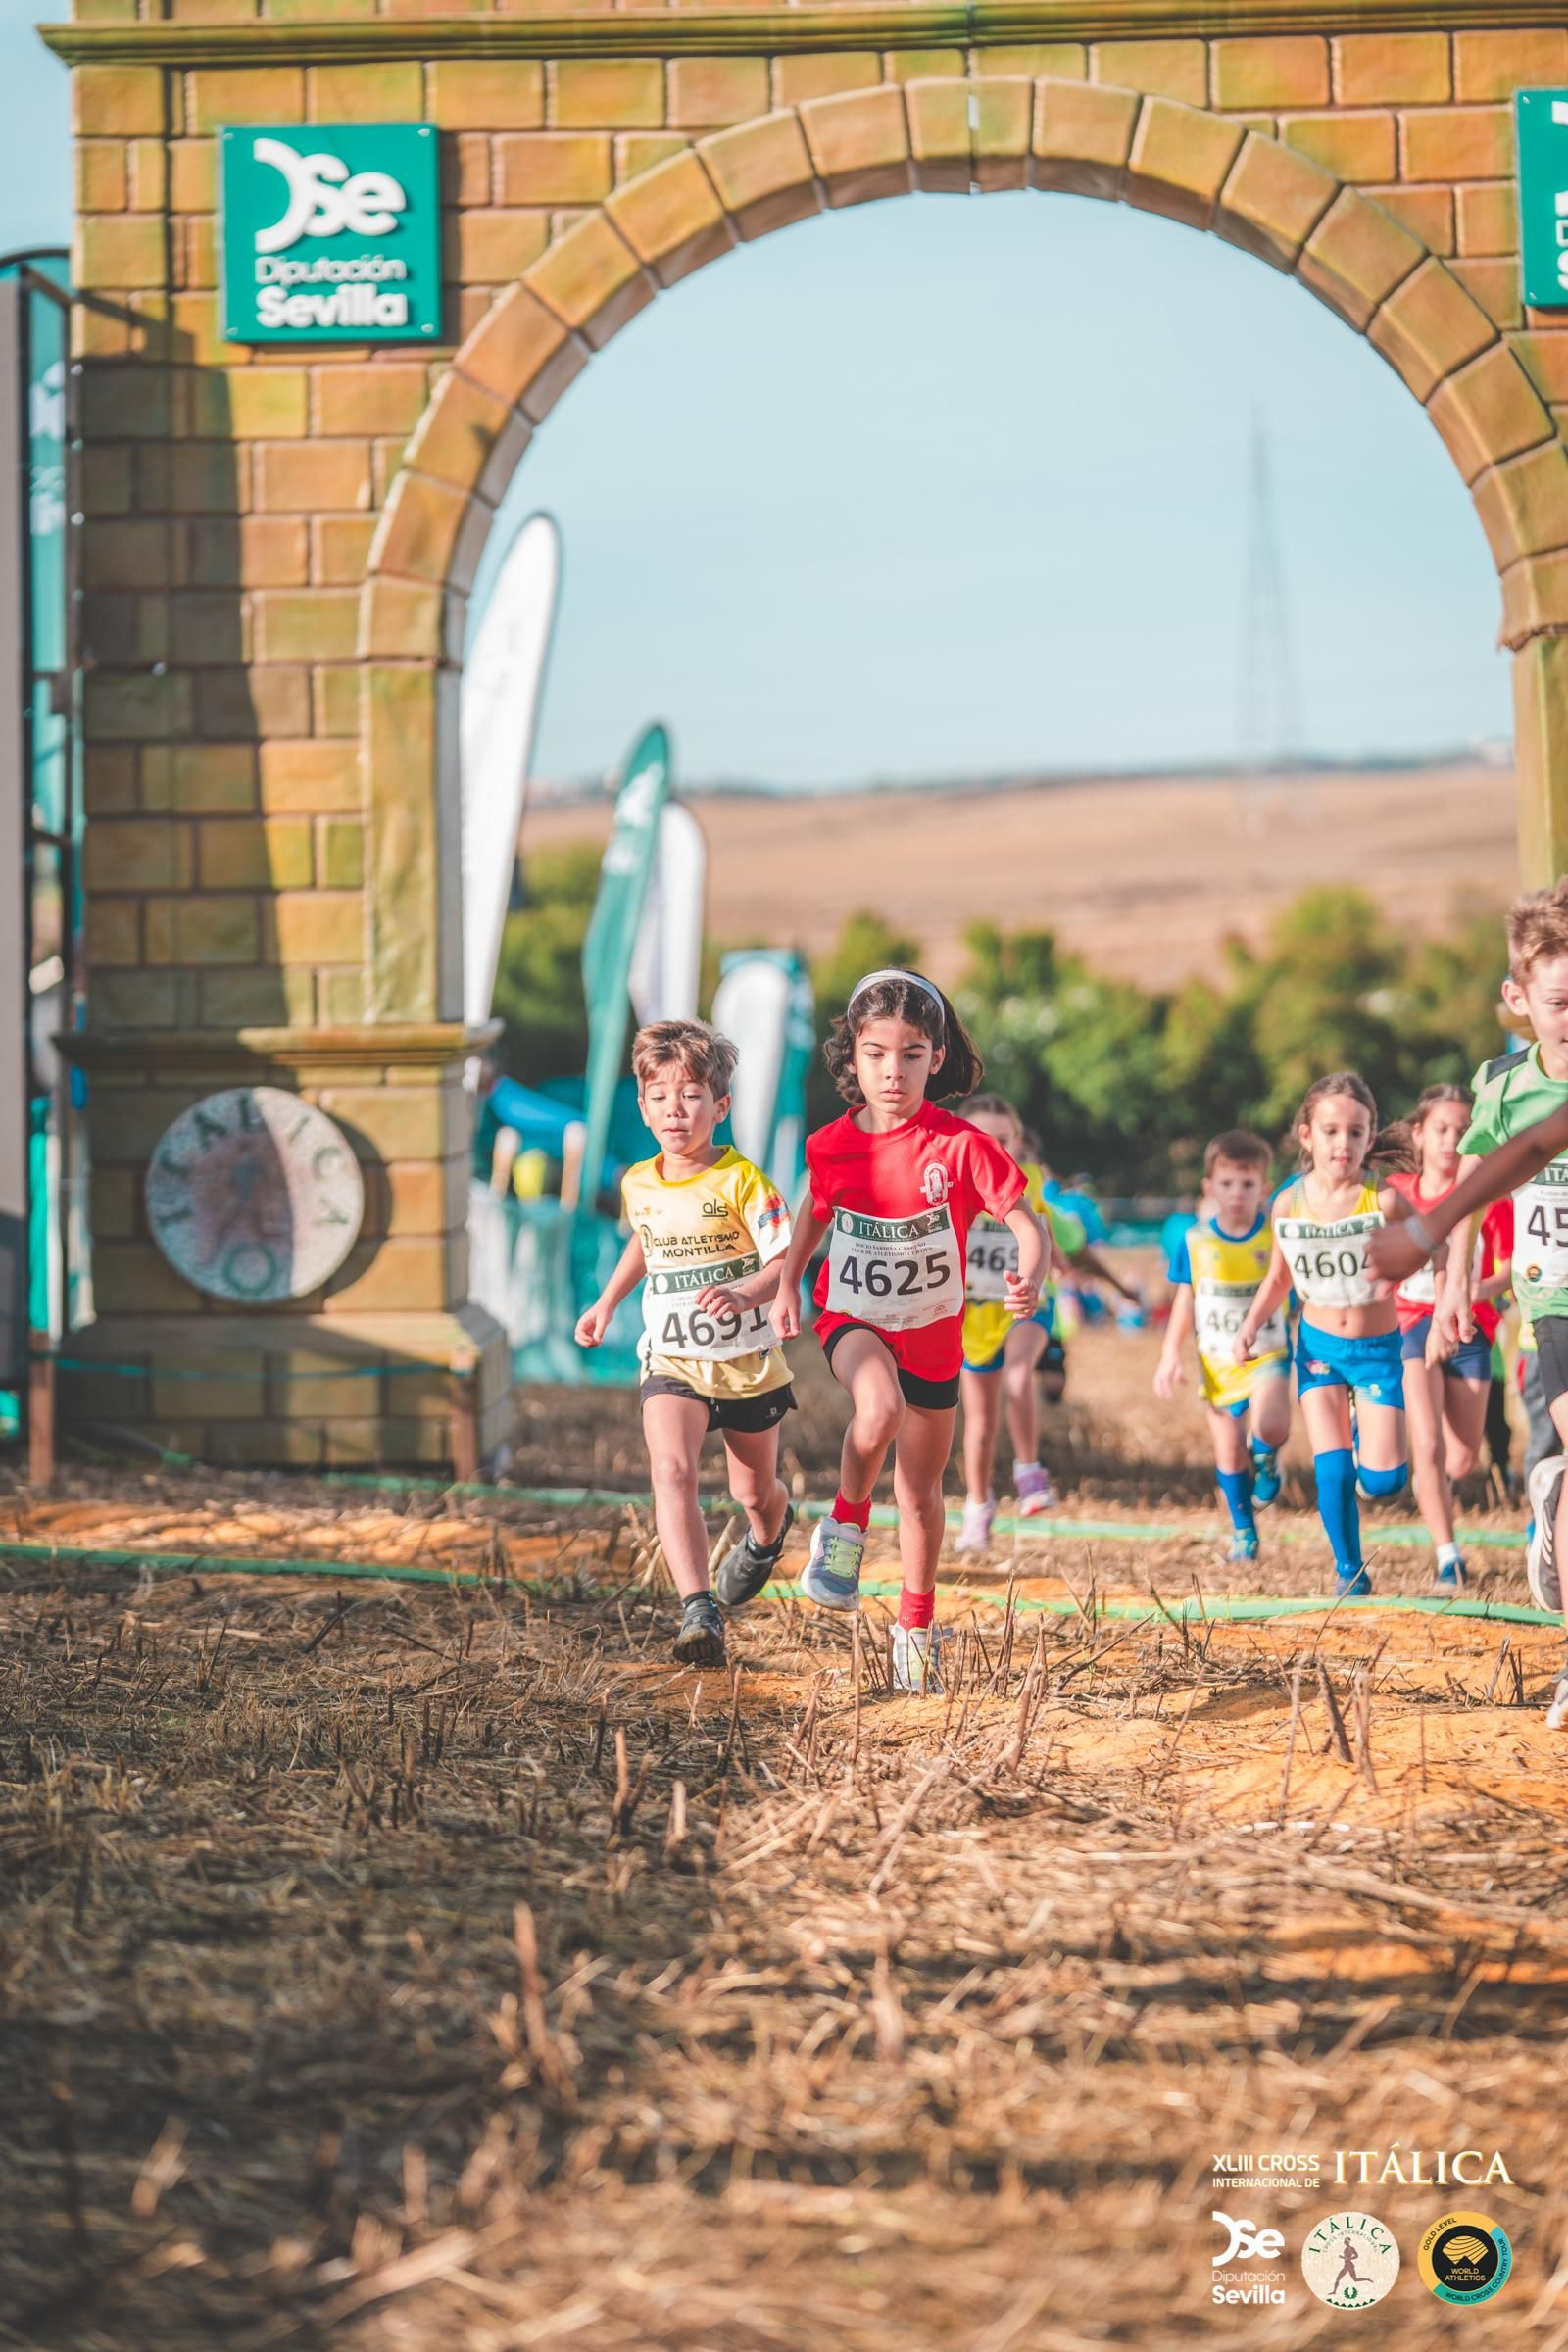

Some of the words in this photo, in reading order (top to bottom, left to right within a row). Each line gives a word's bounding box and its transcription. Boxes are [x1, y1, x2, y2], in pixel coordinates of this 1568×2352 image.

[255, 255, 408, 286] Diputación
[256, 283, 408, 328] Sevilla
[654, 1236, 677, 1248] CLUB
[681, 1230, 740, 1246] ATLETISMO
[859, 1221, 919, 1239] ITÁLICA
[662, 1243, 737, 1258] MONTILLA
[969, 1245, 1019, 1273] 465
[674, 1267, 734, 1288] ITÁLICA
[839, 1251, 951, 1297] 4625
[662, 1304, 768, 1349] 4691
[1206, 1308, 1277, 1333] 461
